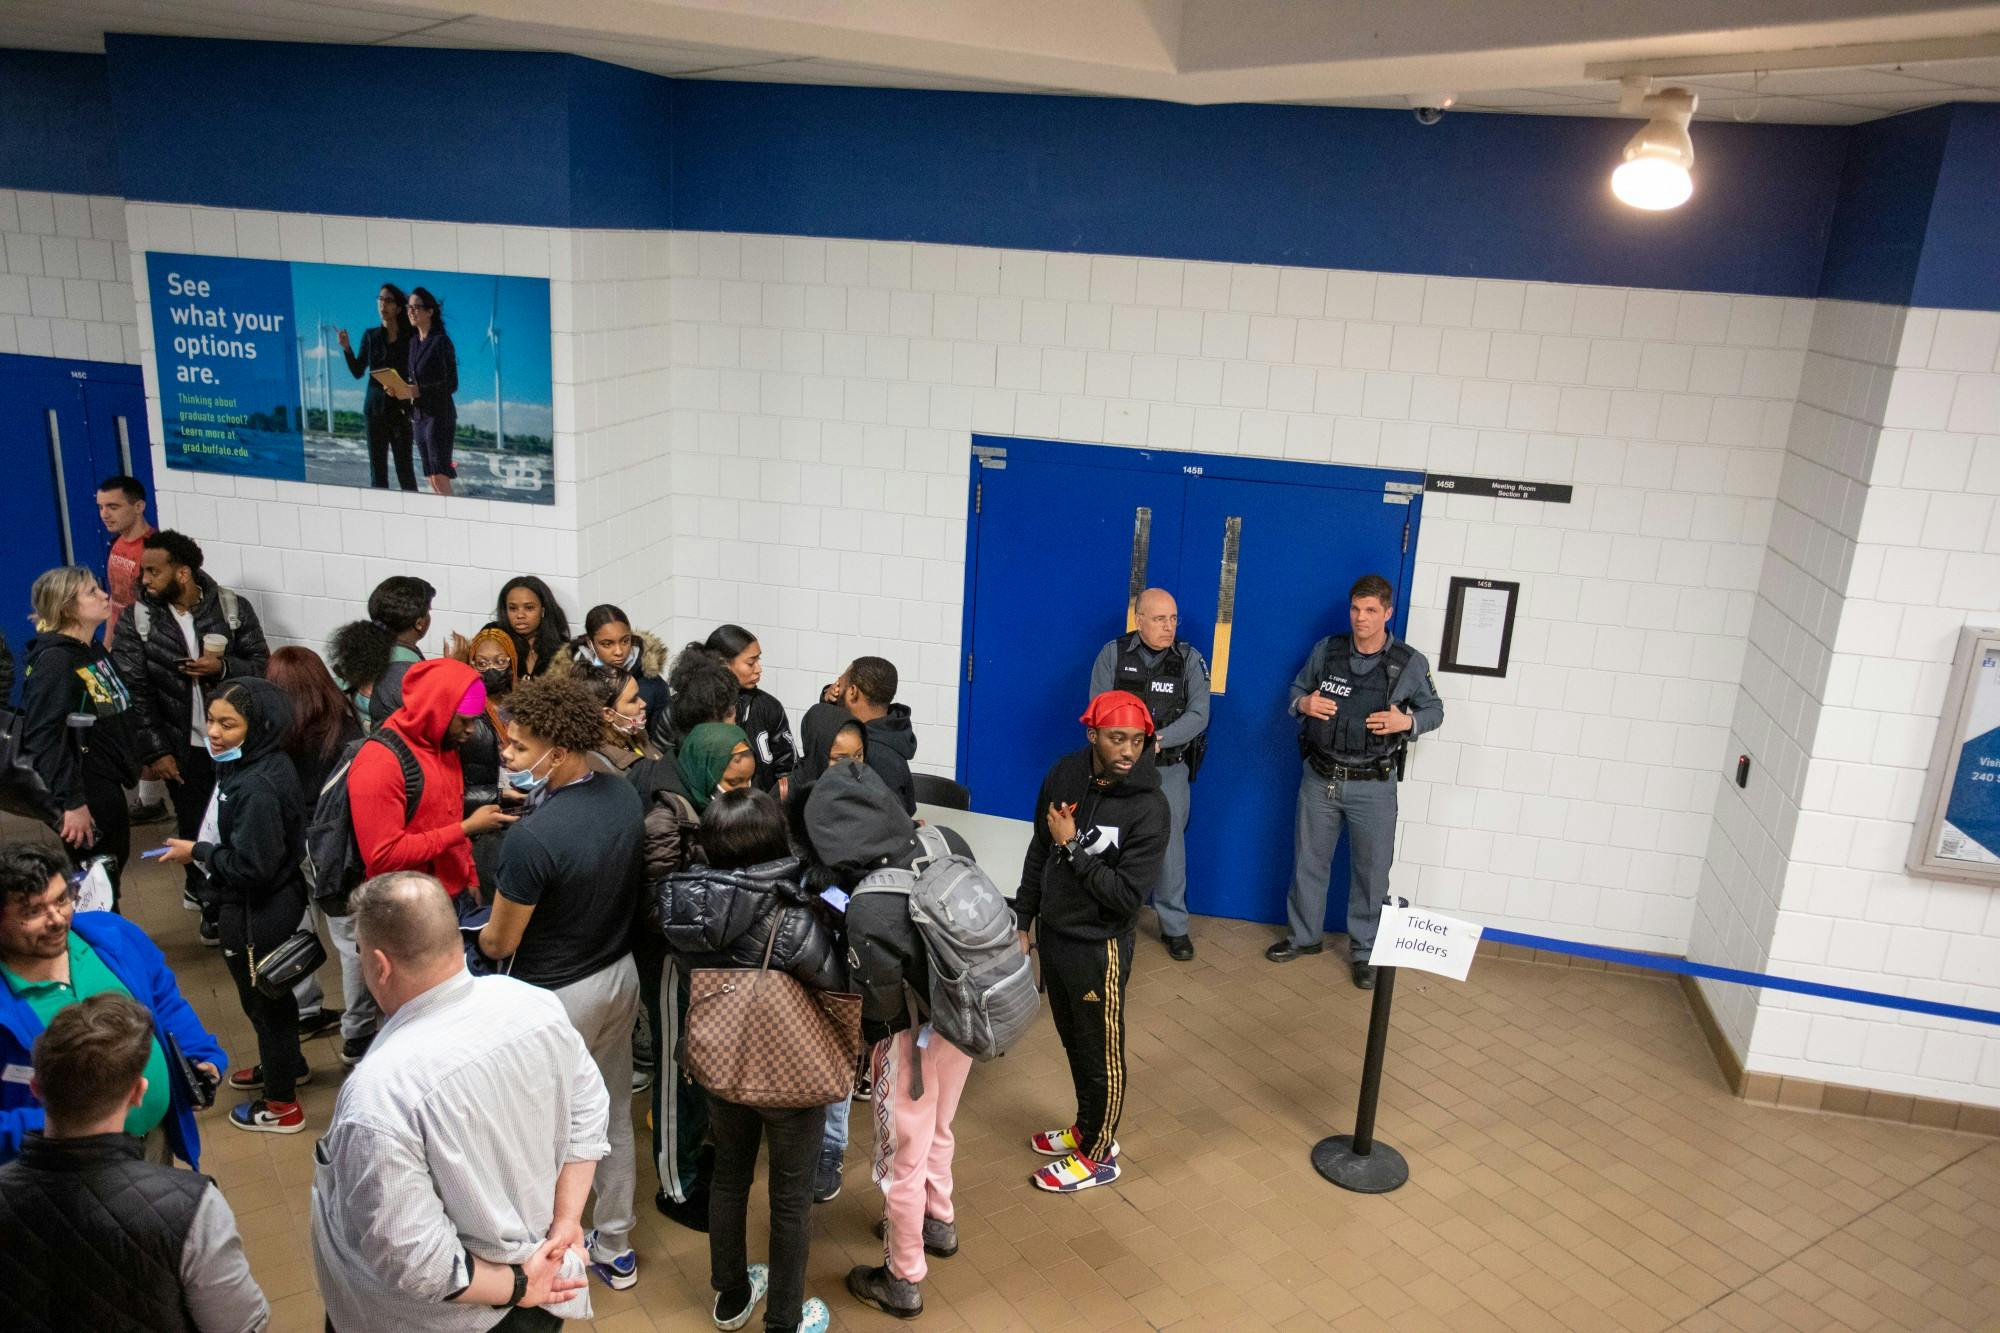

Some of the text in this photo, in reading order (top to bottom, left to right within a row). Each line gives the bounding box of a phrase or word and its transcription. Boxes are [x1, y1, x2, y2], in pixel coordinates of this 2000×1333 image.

[167, 272, 211, 298] See
[170, 303, 285, 335] what your
[173, 333, 257, 360] options
[176, 364, 220, 385] are.
[178, 392, 238, 409] Thinking about
[179, 410, 248, 425] graduate school?
[180, 425, 237, 440] Learn more at
[182, 442, 249, 457] grad.buffalo.edu
[1436, 480, 1455, 489] 145B
[1491, 482, 1537, 492] Meeting Room
[1497, 490, 1521, 498] Section
[1151, 681, 1174, 694] POLICE
[1319, 680, 1352, 697] POLICE
[1971, 771, 1995, 782] 240
[1408, 915, 1449, 937] Ticket
[1395, 937, 1449, 959] Holders
